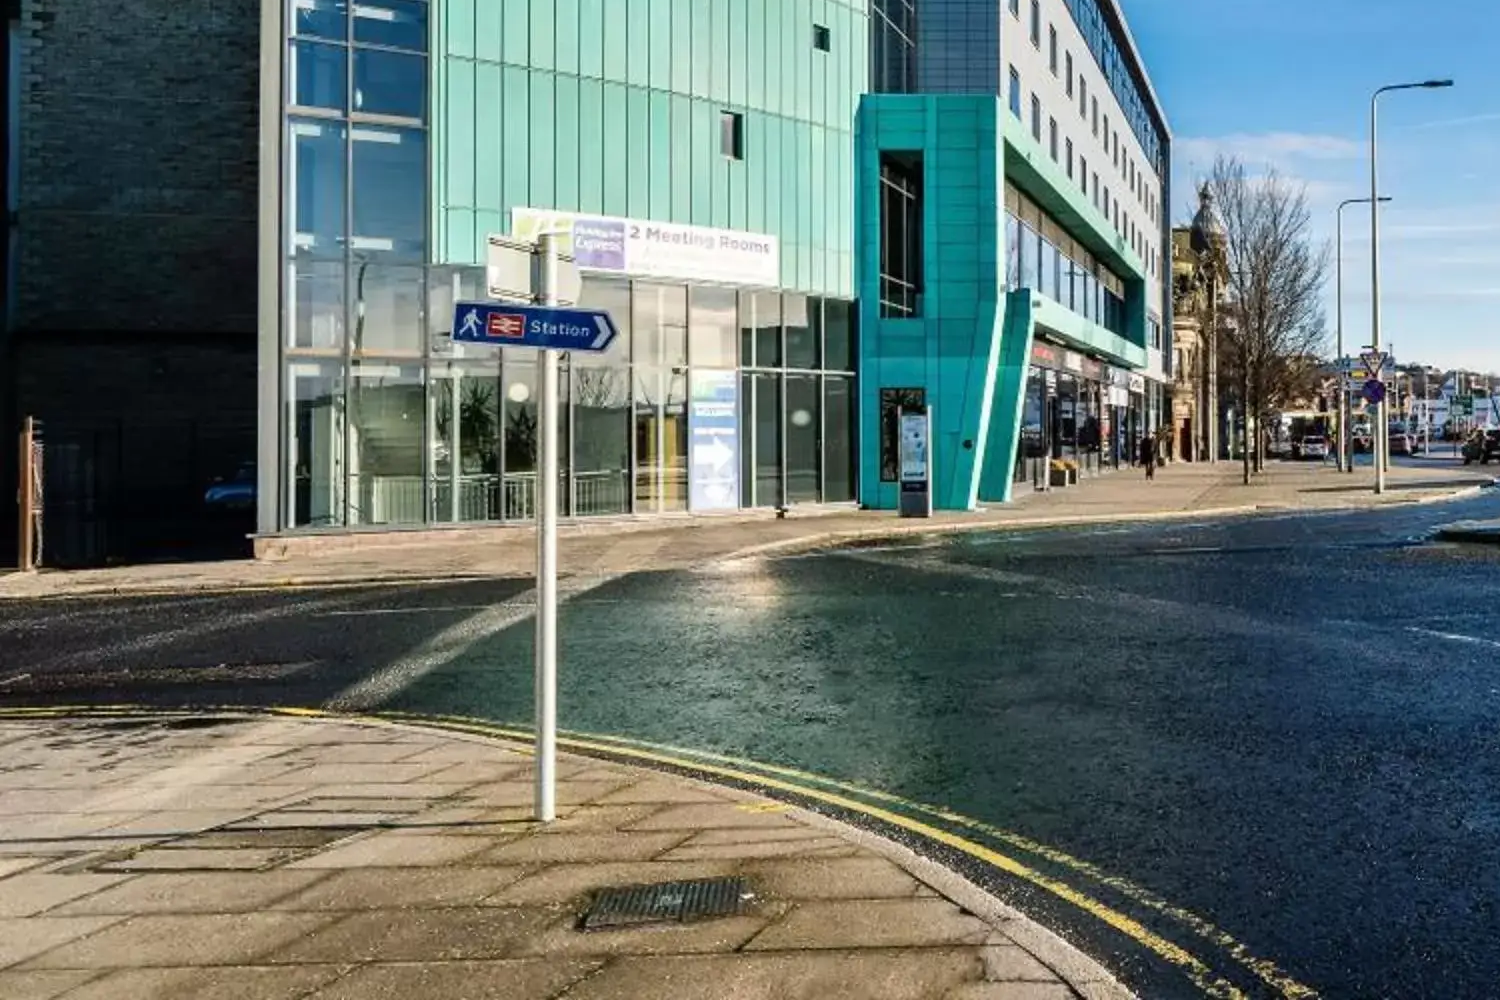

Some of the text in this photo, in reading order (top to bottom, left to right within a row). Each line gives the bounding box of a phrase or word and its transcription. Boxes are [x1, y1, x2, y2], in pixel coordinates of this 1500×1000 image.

[629, 225, 641, 239] 2
[645, 226, 715, 249] Meeting
[719, 235, 771, 255] Rooms
[530, 319, 590, 337] Station
